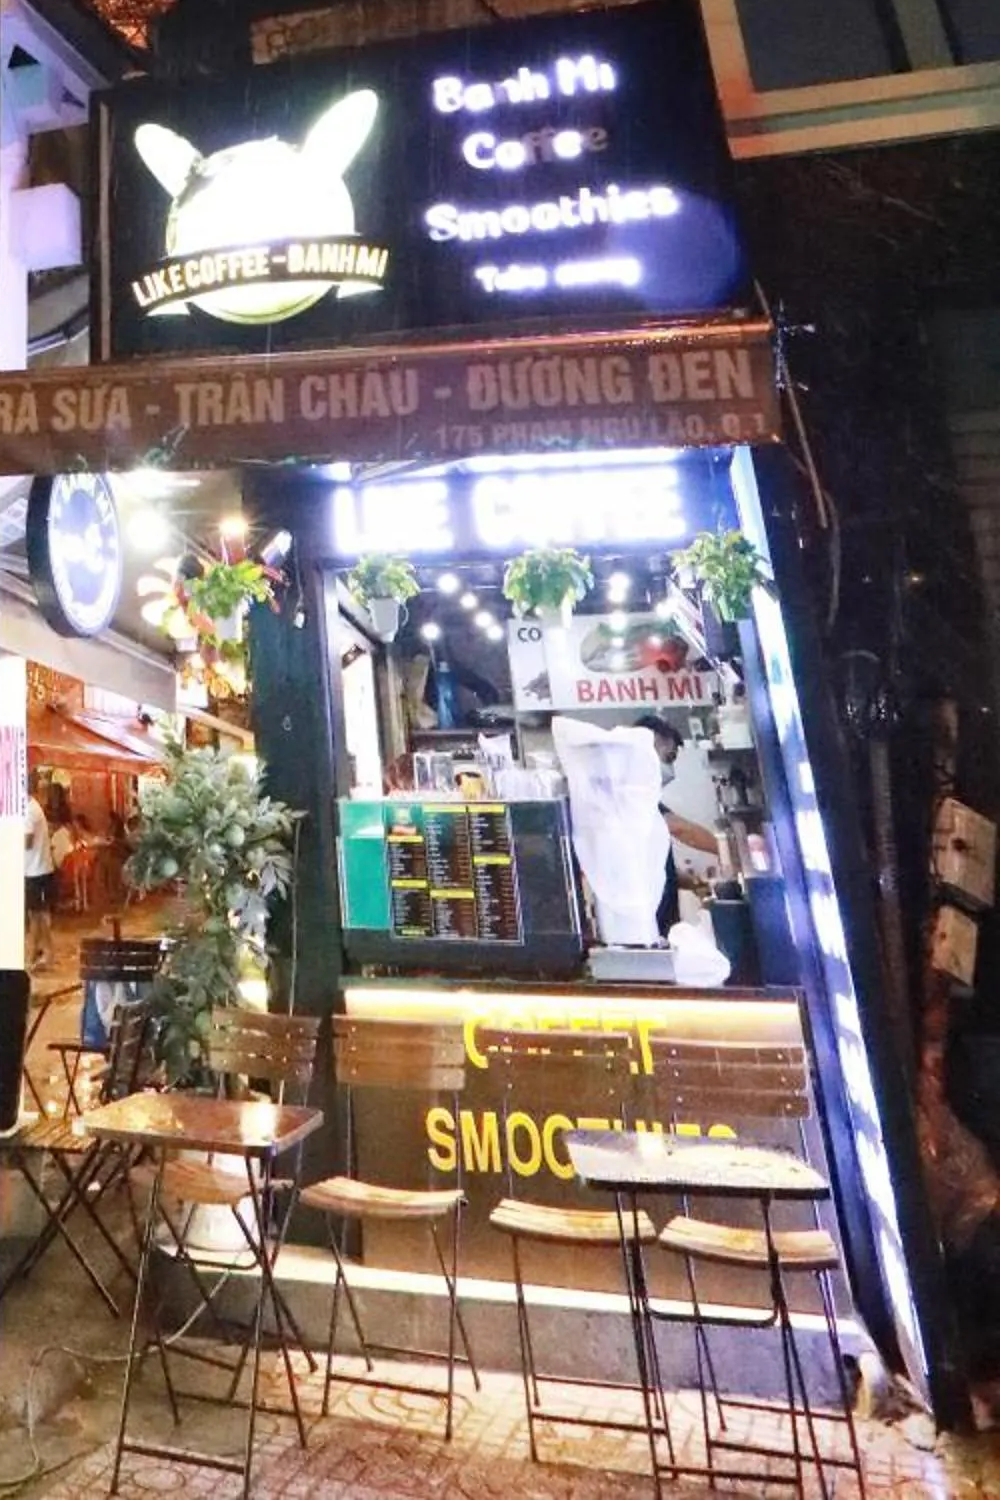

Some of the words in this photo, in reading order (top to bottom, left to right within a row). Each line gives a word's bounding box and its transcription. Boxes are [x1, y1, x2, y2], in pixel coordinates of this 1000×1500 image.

[433, 67, 549, 113] Banh
[556, 55, 616, 96] Mi
[462, 126, 609, 169] Coffee
[425, 184, 680, 241] Smoothies
[131, 263, 185, 307] LIKE
[185, 247, 270, 288] COFFEE
[174, 374, 286, 426] TRÂN
[300, 362, 419, 420] CHÂU
[648, 348, 755, 403] ĐEN
[435, 423, 485, 450] 175
[575, 676, 660, 704] BANH
[667, 674, 705, 702] MI
